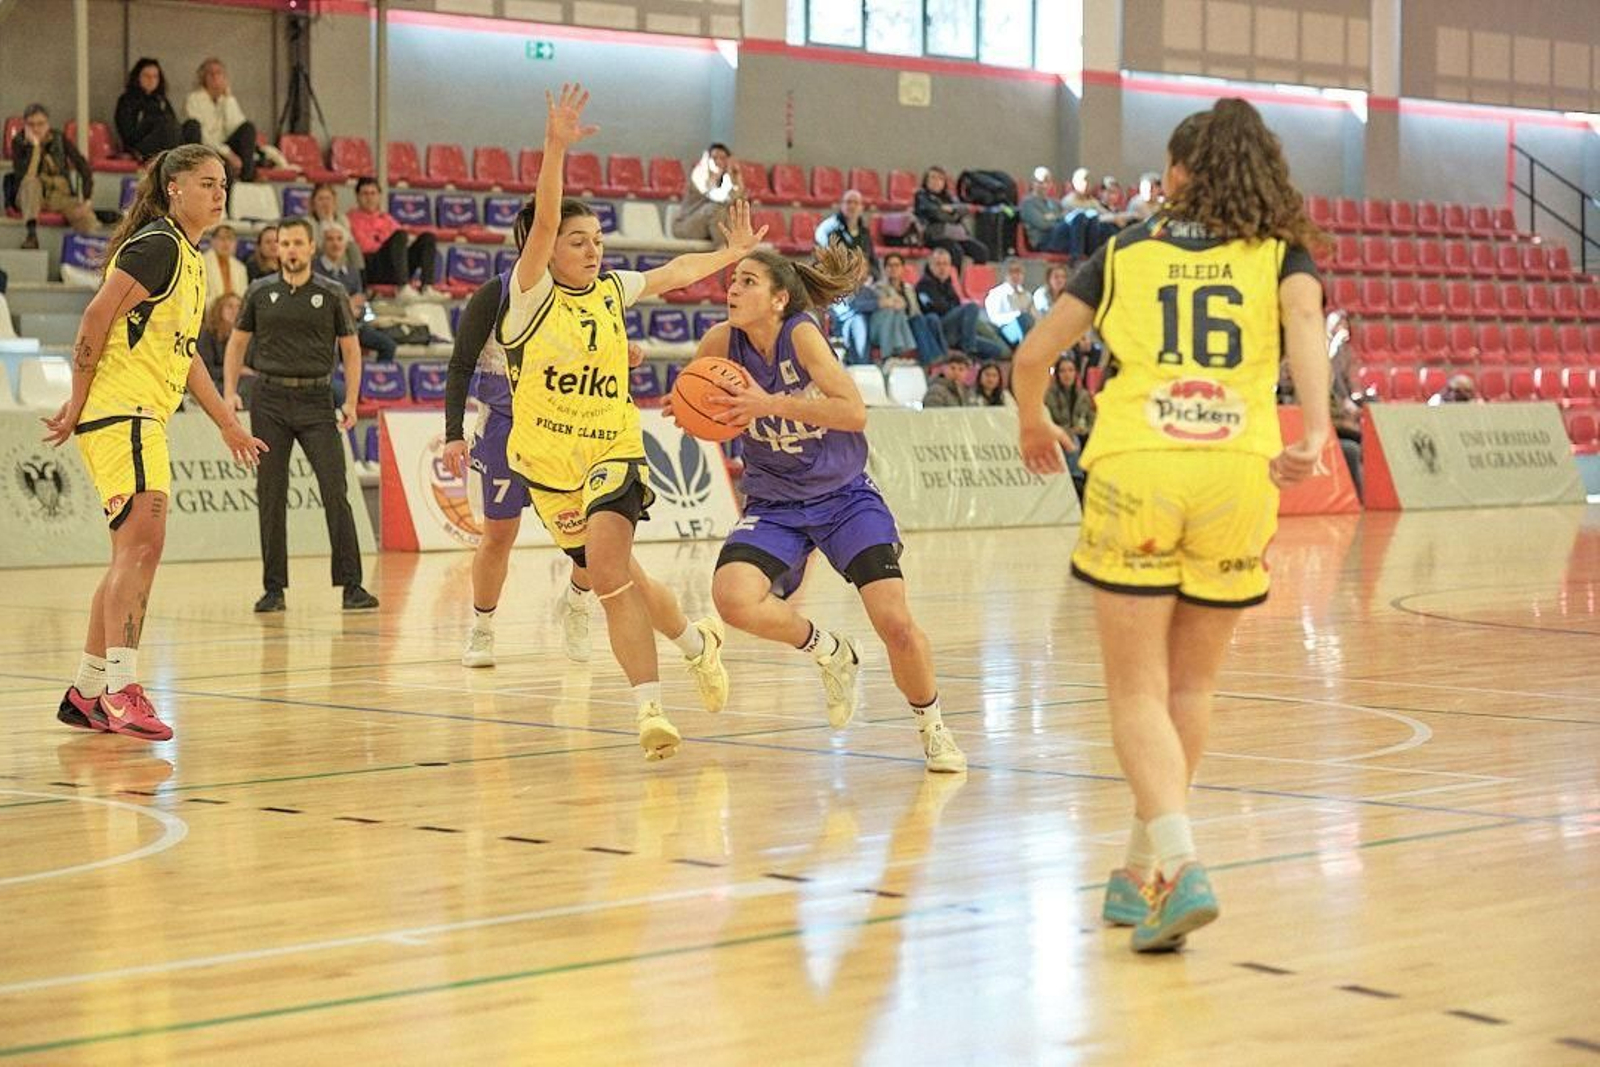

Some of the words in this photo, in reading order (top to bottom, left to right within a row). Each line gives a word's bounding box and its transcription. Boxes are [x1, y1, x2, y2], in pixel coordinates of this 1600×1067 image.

[1168, 263, 1233, 279] BLEDA
[580, 319, 597, 351] 7
[1157, 284, 1243, 369] 16
[543, 365, 618, 398] teika
[1155, 399, 1241, 425] Picken
[913, 443, 1022, 463] UNIVERSIDA
[492, 478, 511, 503] 7
